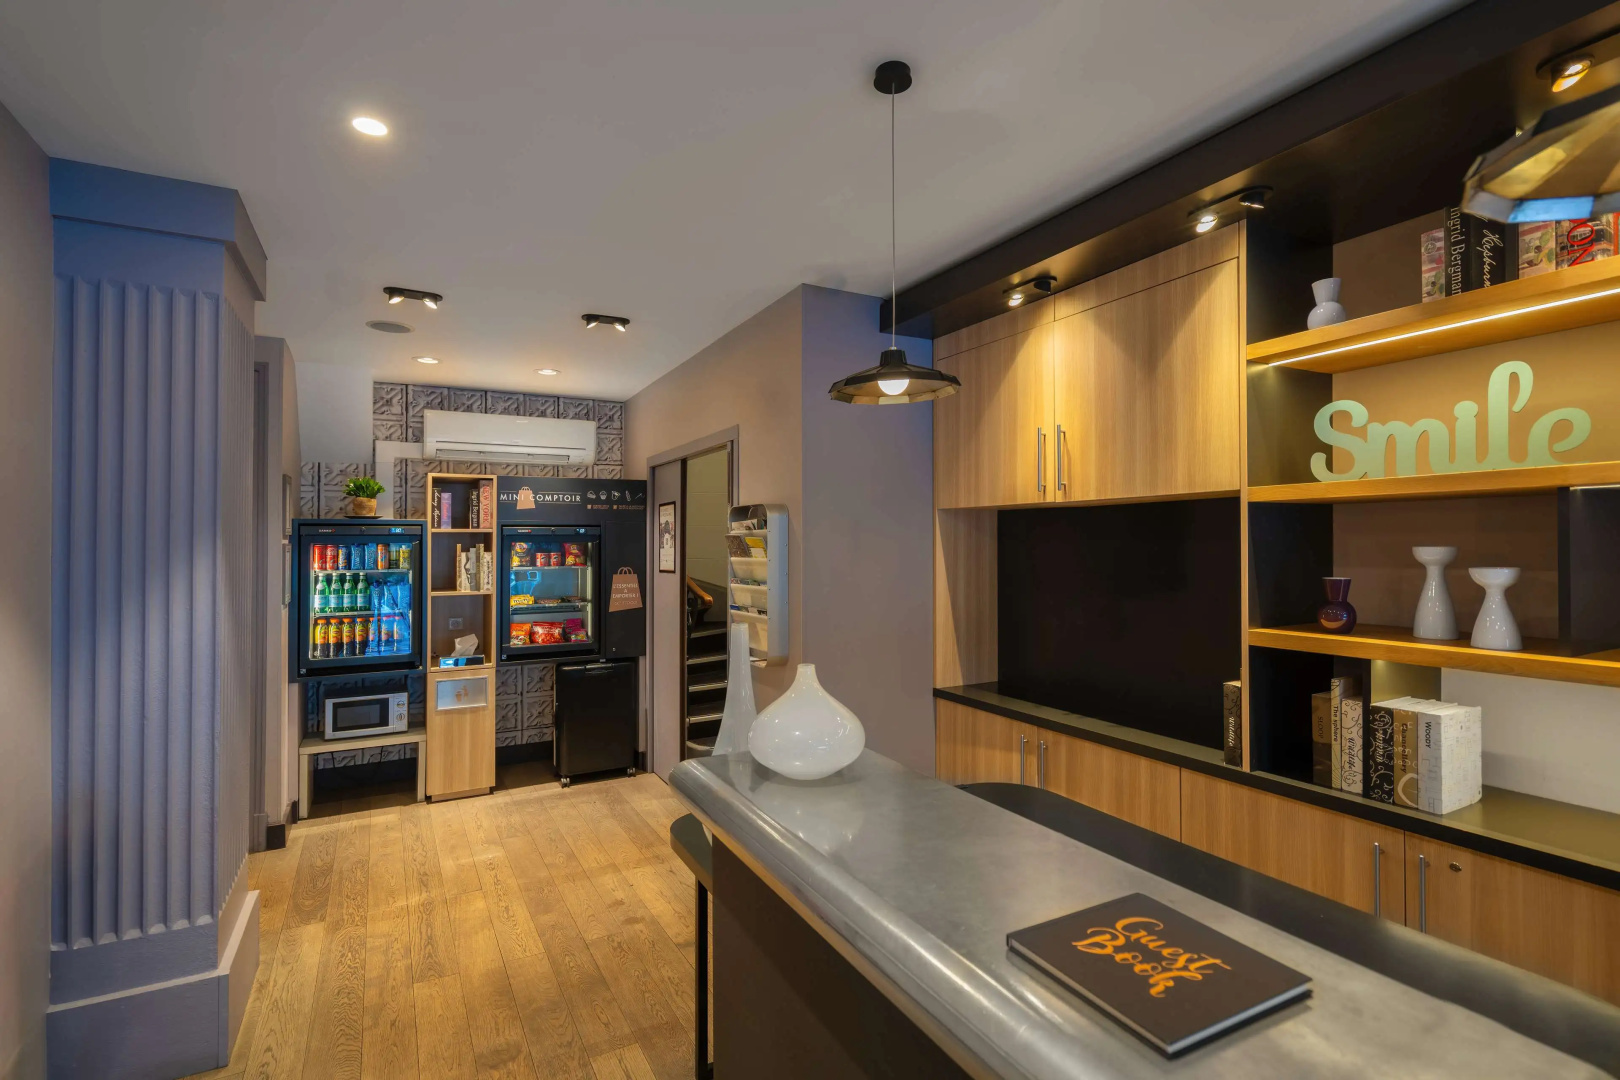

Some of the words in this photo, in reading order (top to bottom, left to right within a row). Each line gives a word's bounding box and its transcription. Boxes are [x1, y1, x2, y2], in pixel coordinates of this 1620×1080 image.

[1310, 360, 1592, 482] Smile
[500, 493, 525, 501] MINI
[530, 493, 581, 502] COMPTOIR
[1347, 737, 1356, 770] Wildlife
[1400, 723, 1409, 774] Chancellery
[1071, 927, 1203, 998] Book
[1115, 917, 1233, 974] Guest
